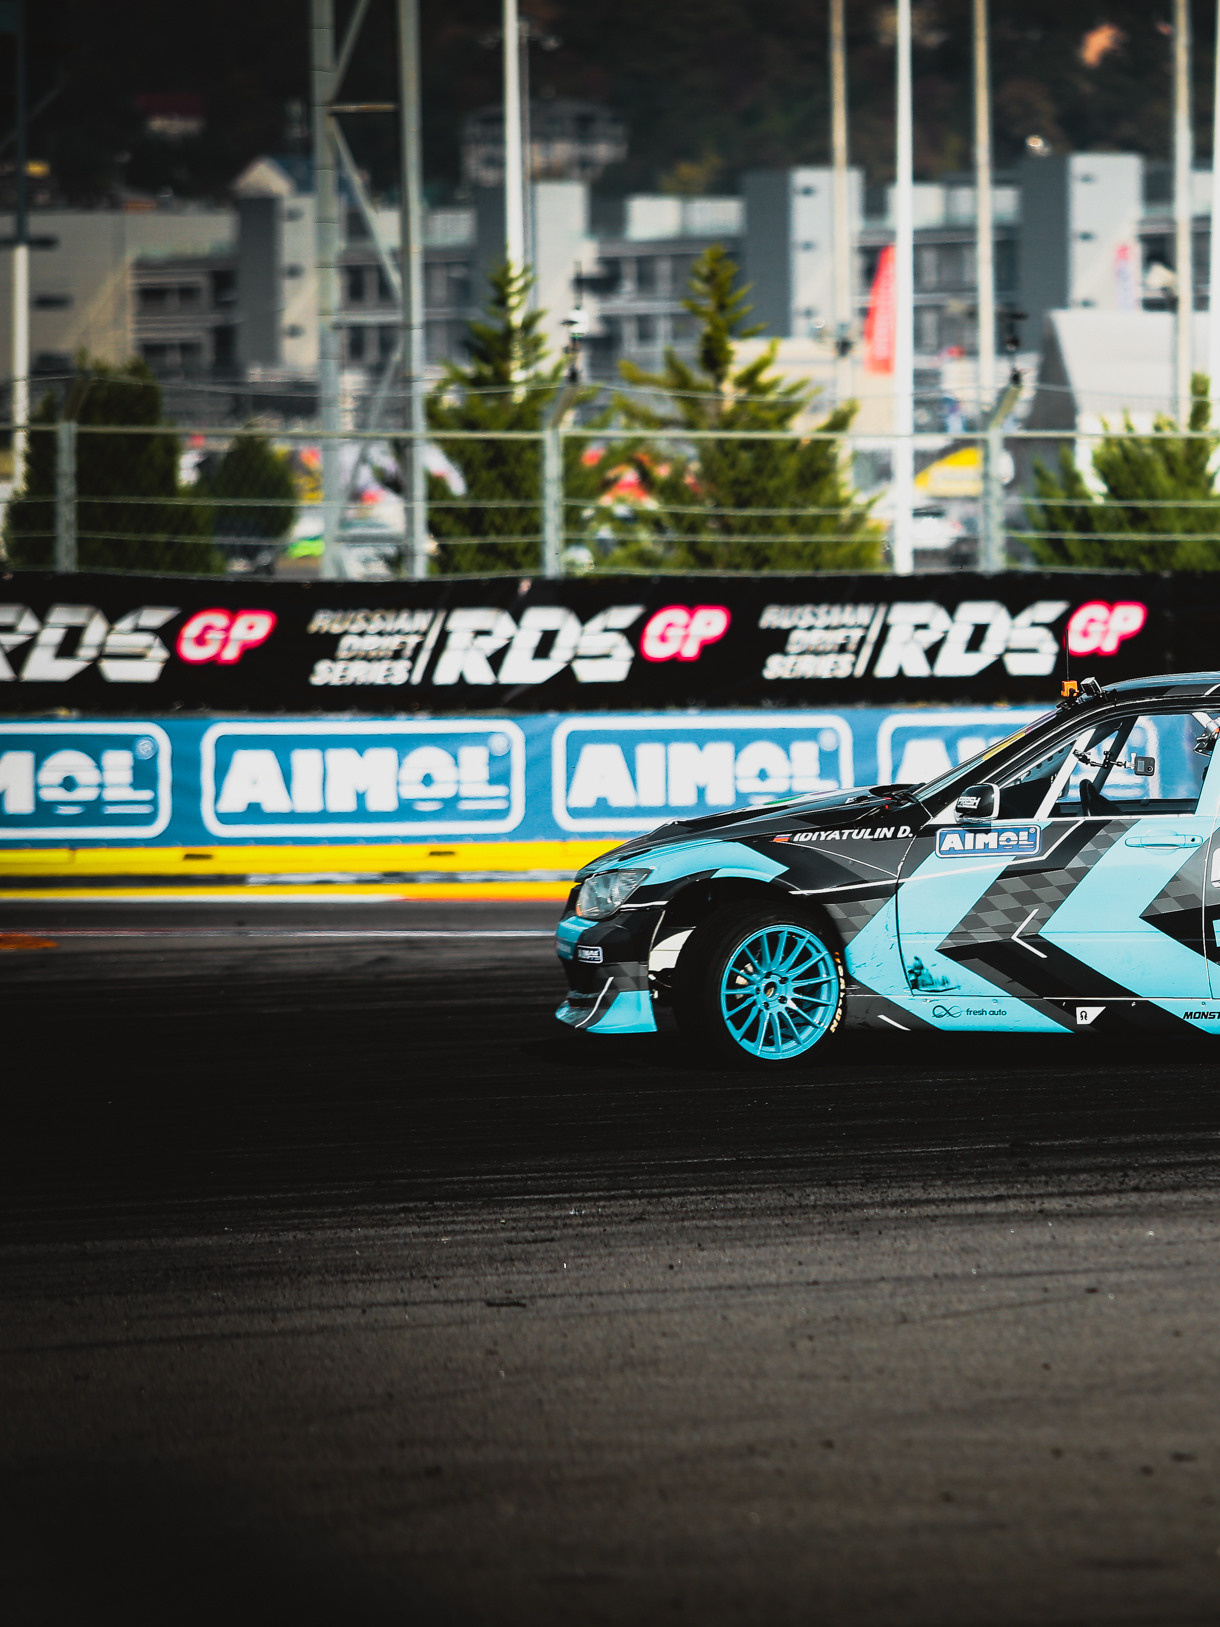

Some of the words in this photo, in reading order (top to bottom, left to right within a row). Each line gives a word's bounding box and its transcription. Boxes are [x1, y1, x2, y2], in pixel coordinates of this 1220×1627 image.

[308, 609, 433, 634] RUSSIAN
[759, 603, 873, 629] RUSSIAN
[177, 608, 278, 665] GP
[336, 634, 424, 659] DRIFT
[432, 605, 646, 685] RDS
[640, 604, 731, 662] GP
[785, 629, 866, 653] DRIFT
[873, 601, 1069, 678] RDS
[1064, 601, 1148, 657] GP
[309, 659, 412, 686] SERIES
[763, 653, 855, 680] SERIES
[216, 746, 509, 813] AIMOL
[567, 741, 839, 807] AIMOL
[793, 826, 890, 842] IDIYATULIN
[897, 826, 914, 838] D.
[940, 831, 1036, 851] AIMOL
[966, 1007, 987, 1016] fresh
[988, 1008, 1007, 1016] auto
